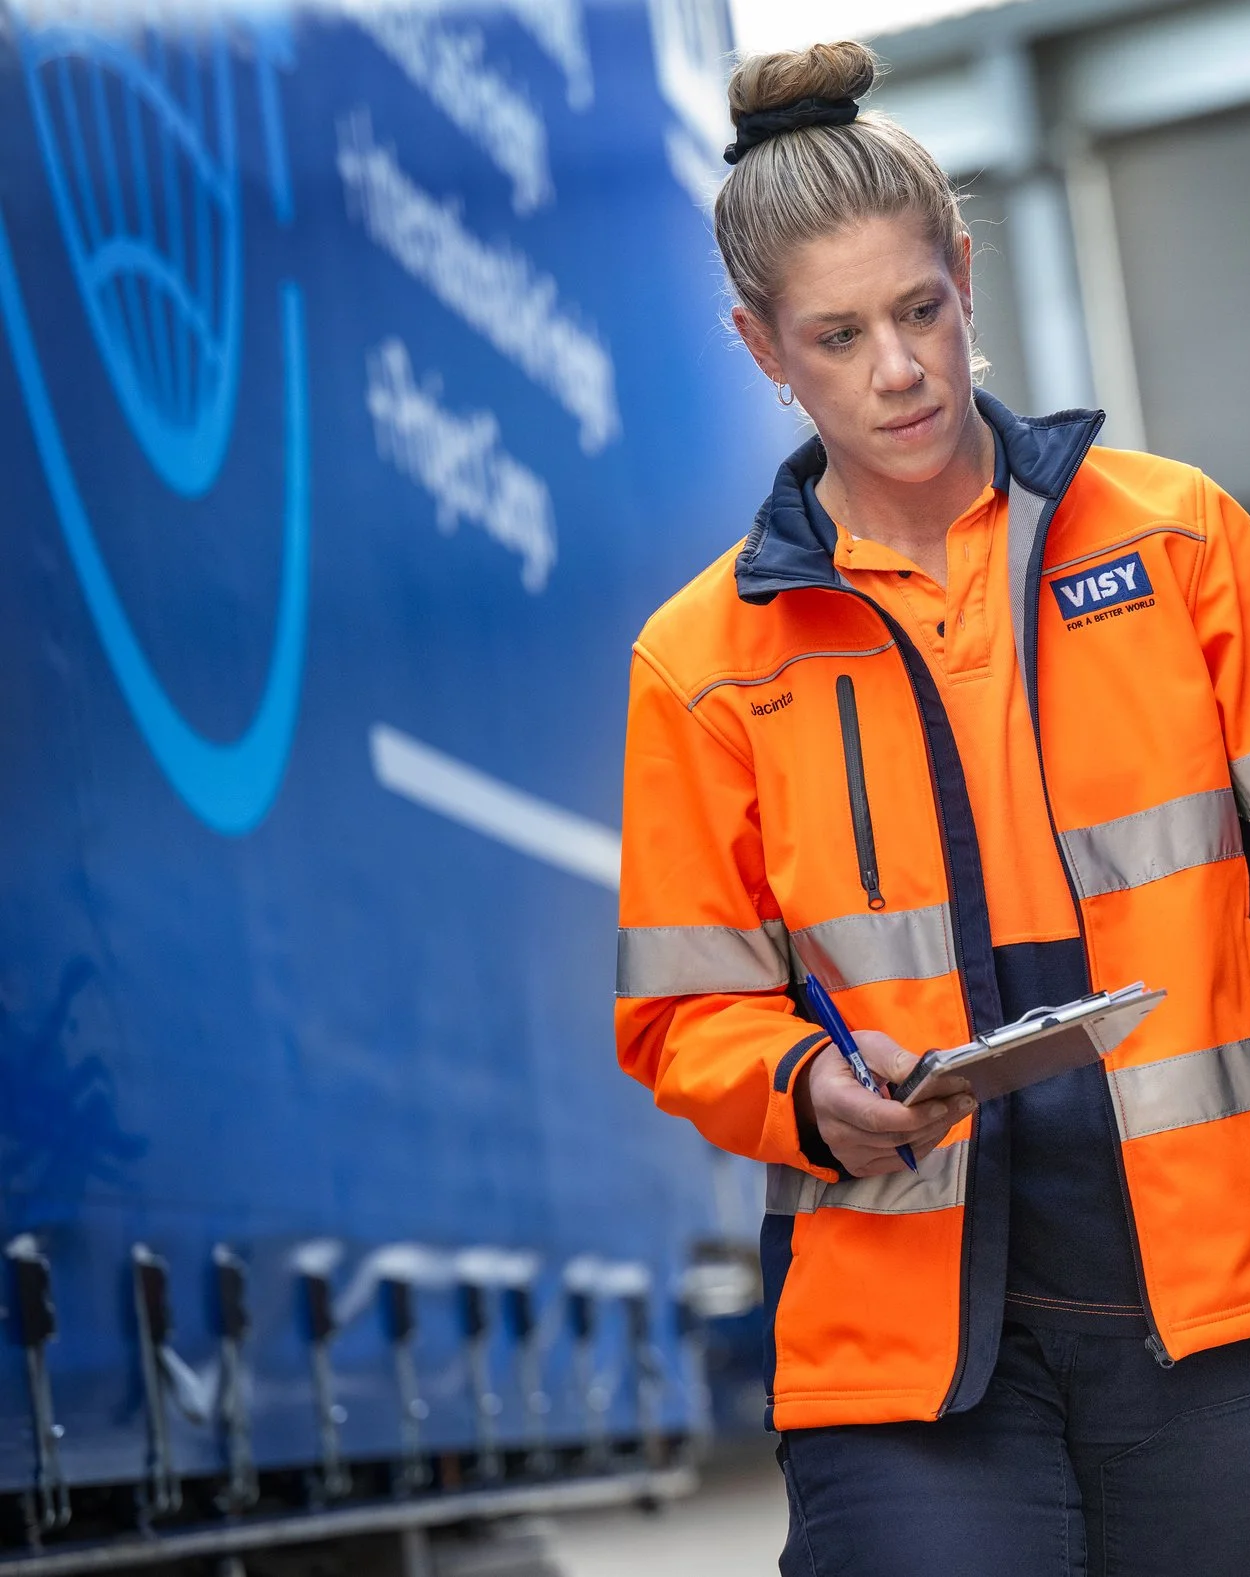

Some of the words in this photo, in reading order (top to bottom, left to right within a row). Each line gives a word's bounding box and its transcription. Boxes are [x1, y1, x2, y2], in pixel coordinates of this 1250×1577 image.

[1060, 562, 1136, 608] VISY
[1066, 621, 1083, 631] FOR
[1085, 617, 1092, 626] A
[1094, 608, 1123, 622] BETTER
[1125, 599, 1155, 612] WORLD
[751, 692, 793, 716] Jacinta
